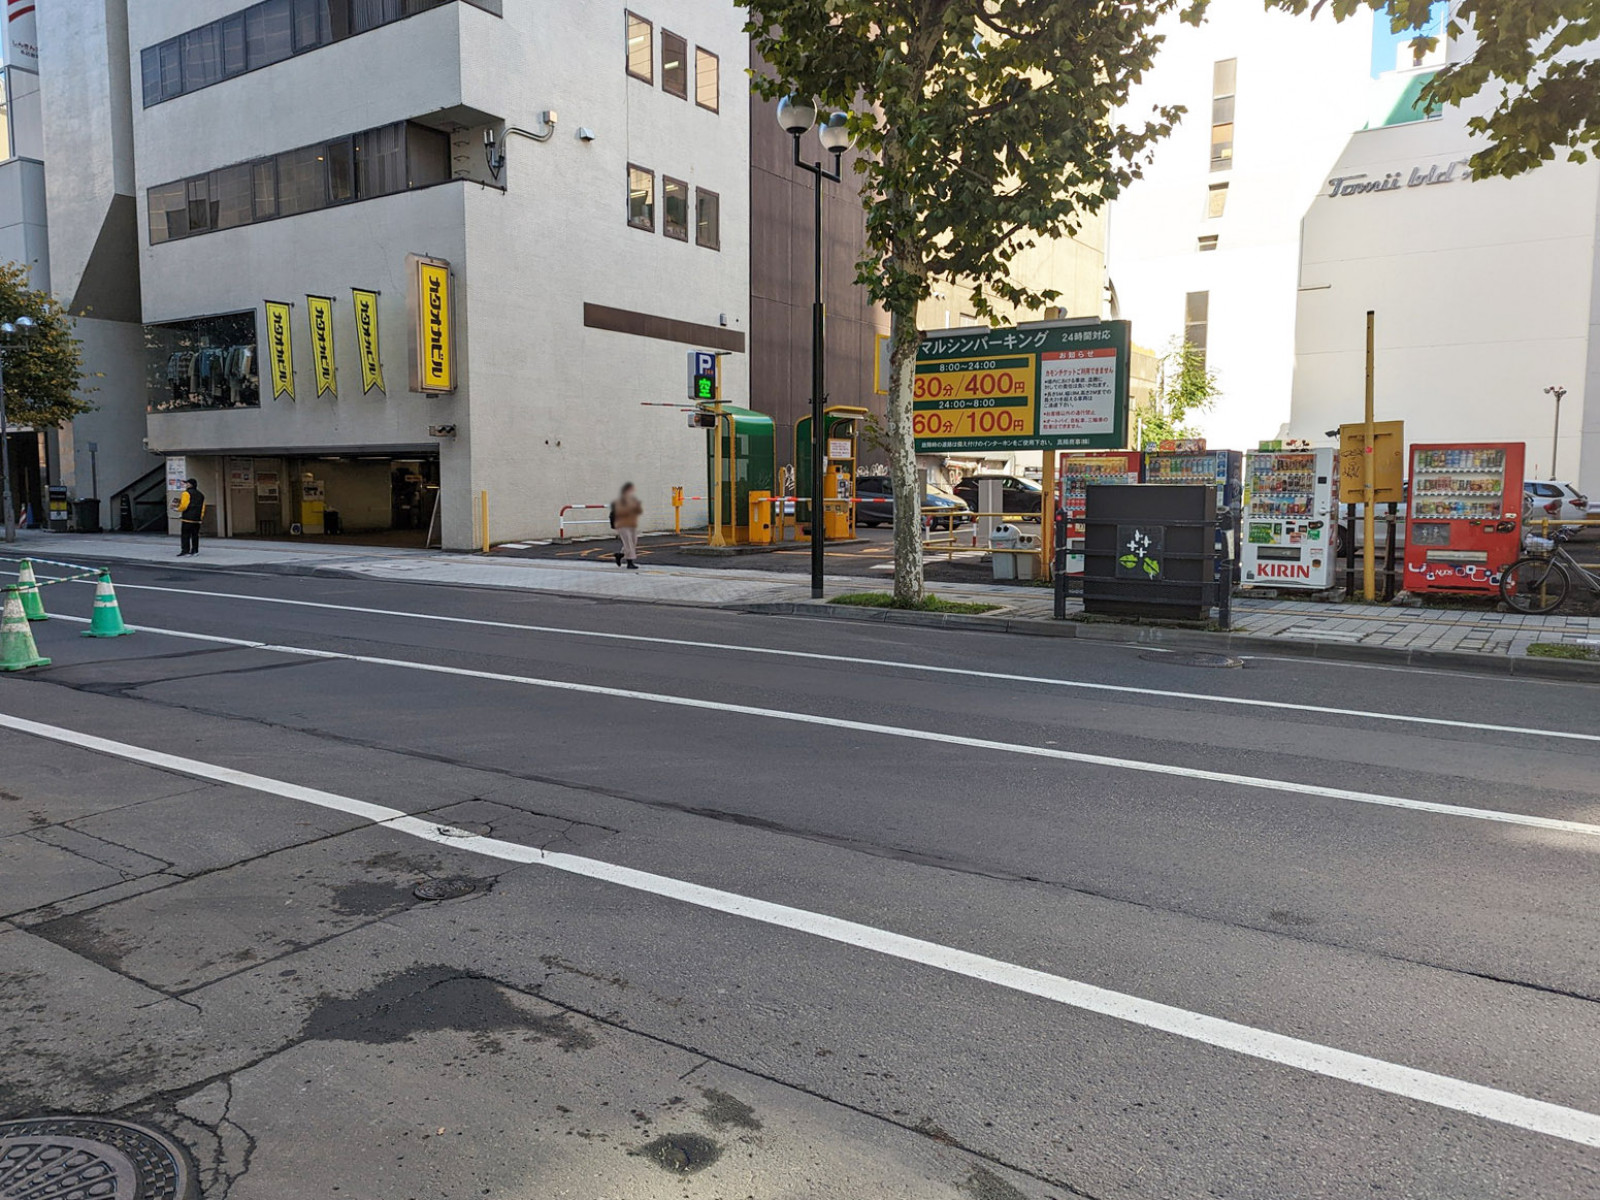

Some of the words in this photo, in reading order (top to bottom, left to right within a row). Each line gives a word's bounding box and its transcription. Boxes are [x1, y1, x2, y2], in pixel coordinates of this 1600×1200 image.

[1328, 171, 1402, 197] Tomii
[1407, 158, 1473, 187] bld
[429, 275, 444, 379] カタオカビル
[921, 330, 1049, 355] マルシンパーキング
[1062, 330, 1111, 342] 24時間対応
[699, 354, 712, 374] P
[1059, 351, 1094, 359] お知らせ
[698, 378, 711, 398] 空
[1257, 563, 1310, 578] KIRIN
